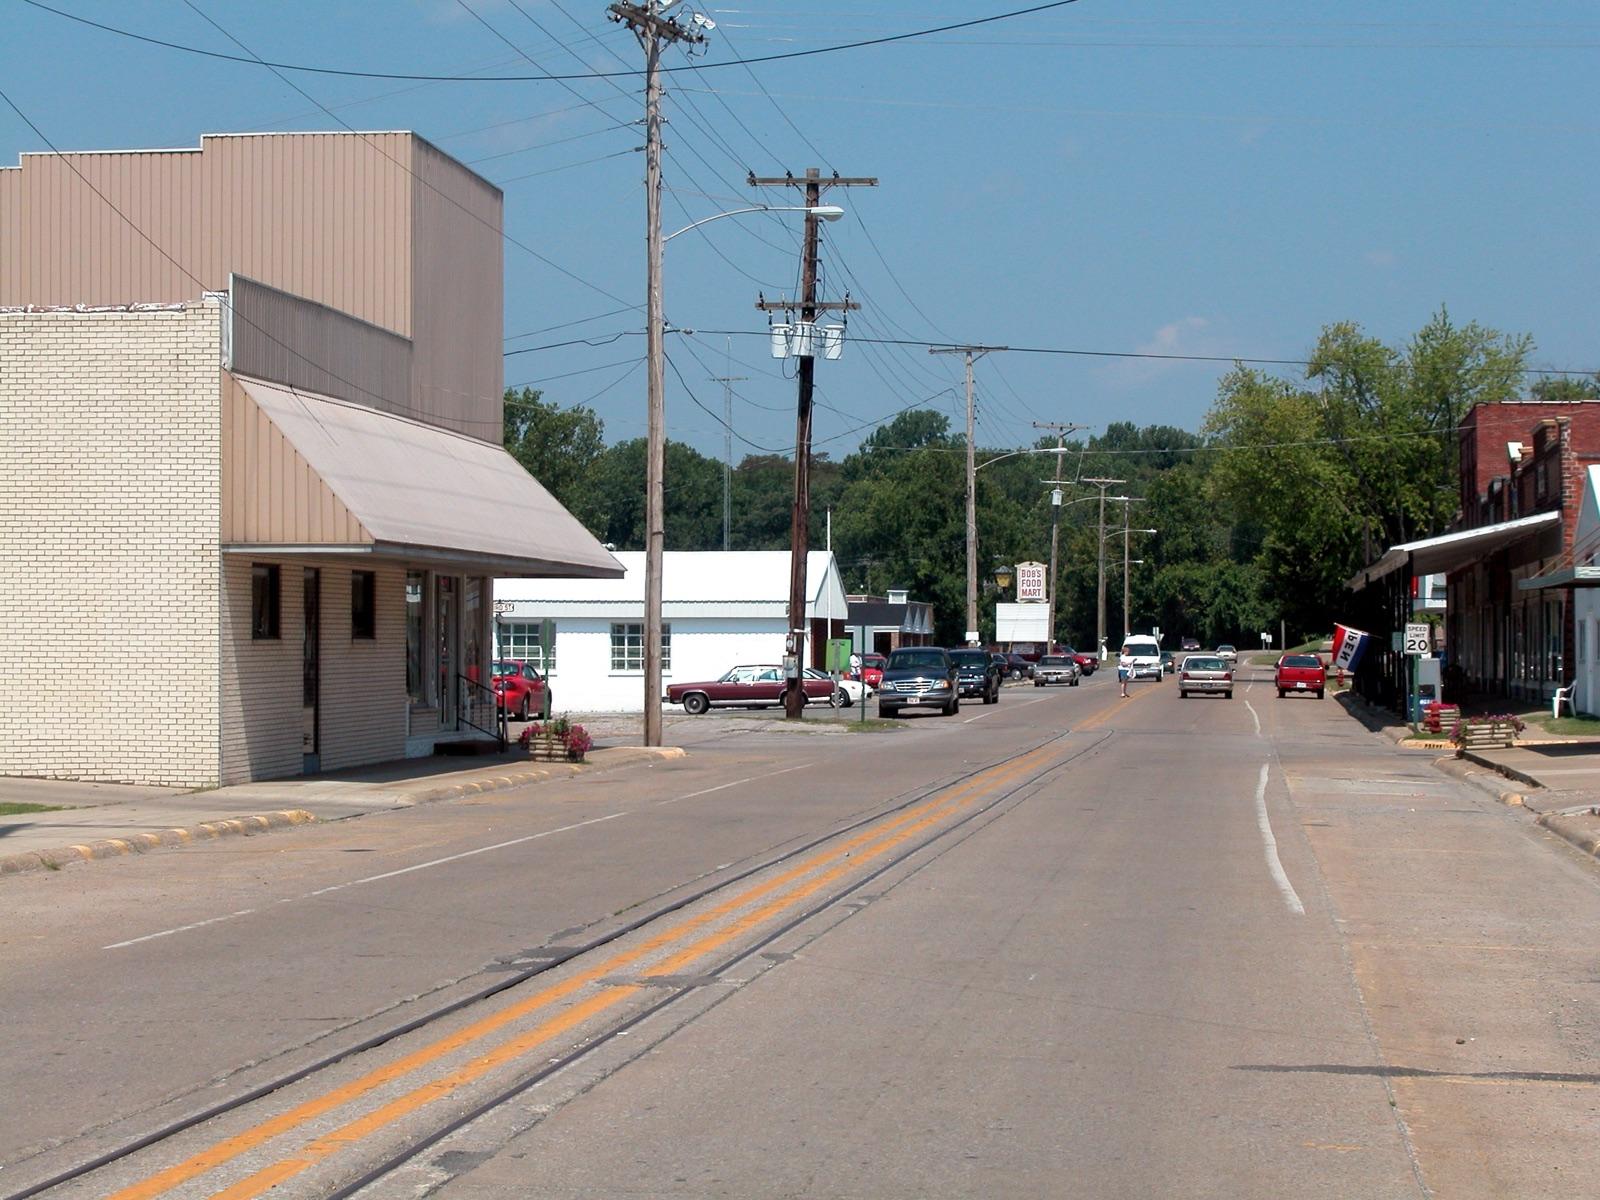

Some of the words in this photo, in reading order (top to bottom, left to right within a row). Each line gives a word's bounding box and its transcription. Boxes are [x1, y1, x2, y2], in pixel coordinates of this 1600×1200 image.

[1021, 569, 1042, 578] BOB'S
[1021, 579, 1042, 587] FOOD
[1021, 588, 1042, 597] MART
[1407, 639, 1428, 651] 20
